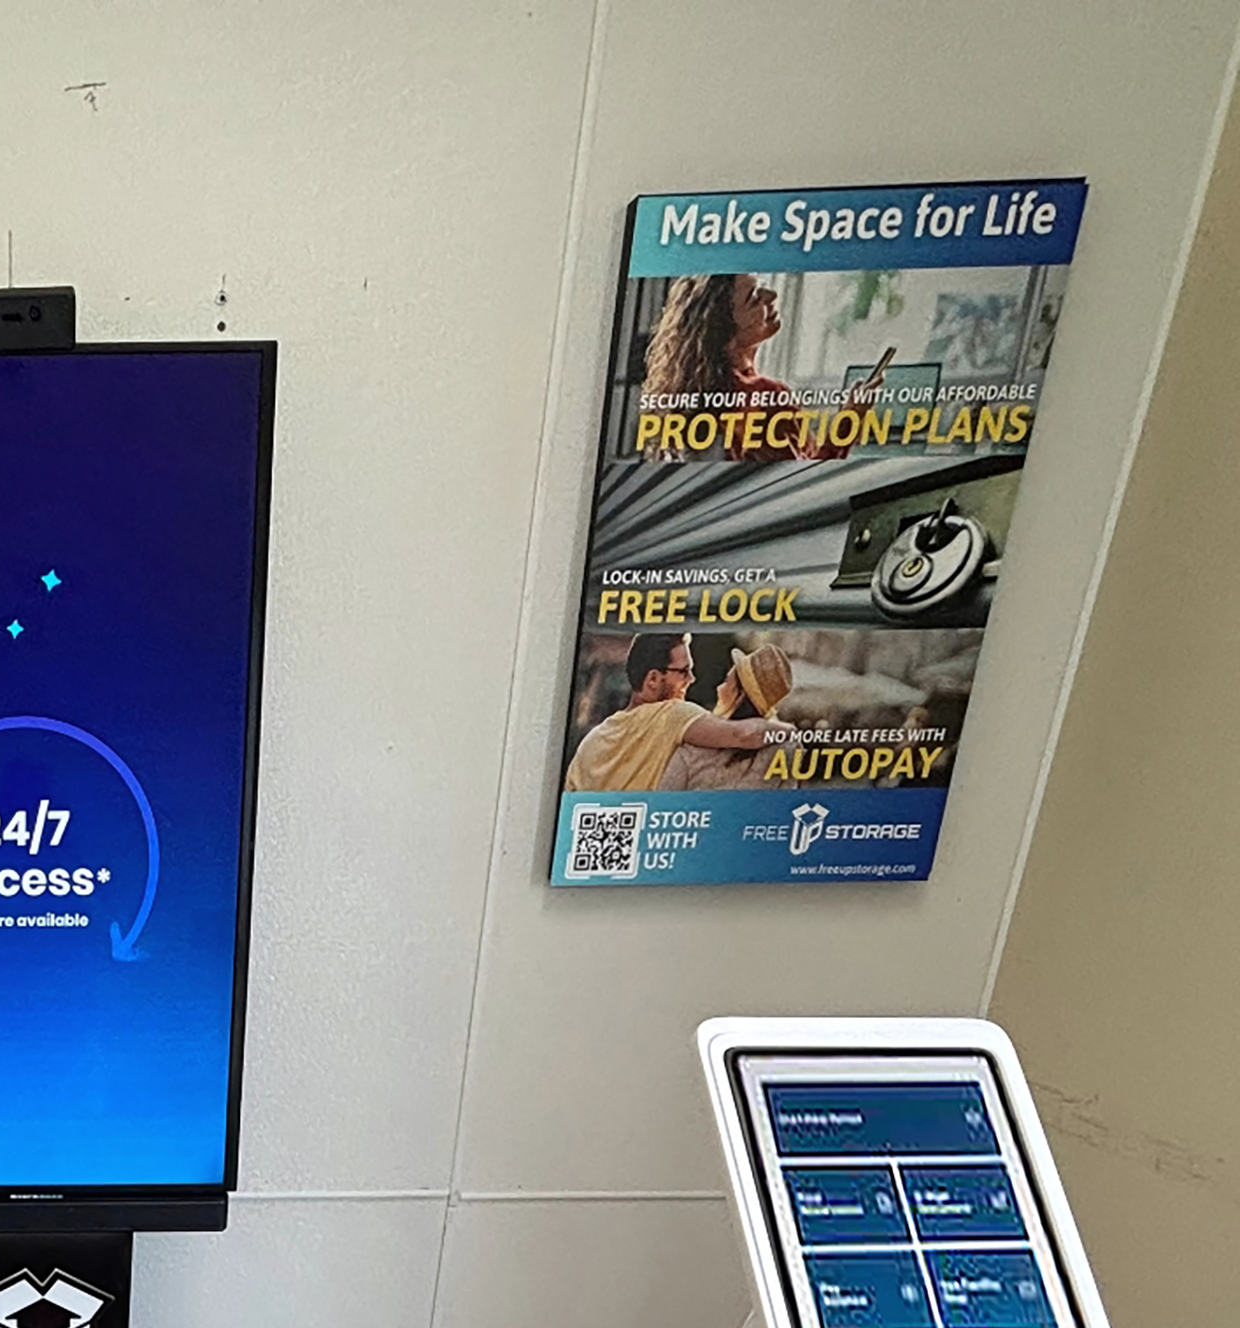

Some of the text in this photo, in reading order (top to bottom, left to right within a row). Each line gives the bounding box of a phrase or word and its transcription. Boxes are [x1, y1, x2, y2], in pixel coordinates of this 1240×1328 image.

[660, 190, 1057, 252] Make Space for Life
[640, 383, 1037, 410] SECURE YOUR BELONGINGS WITH OUR AFFORDABLE
[636, 404, 1031, 452] PROTECTION PLANS
[602, 568, 777, 585] LOCK-IN SAVINGS, GET A
[598, 587, 800, 624] FREE LOCK
[764, 728, 946, 744] NO MORE LATE FEES WITH
[763, 747, 943, 781] AUTOPAY
[648, 811, 712, 829] STORE
[647, 832, 698, 850] WITH
[742, 825, 789, 841] FREE
[824, 824, 922, 839] STORAGE
[643, 852, 676, 871] US!
[790, 863, 916, 877] www.freeupstorage.com
[16, 912, 90, 927] available
